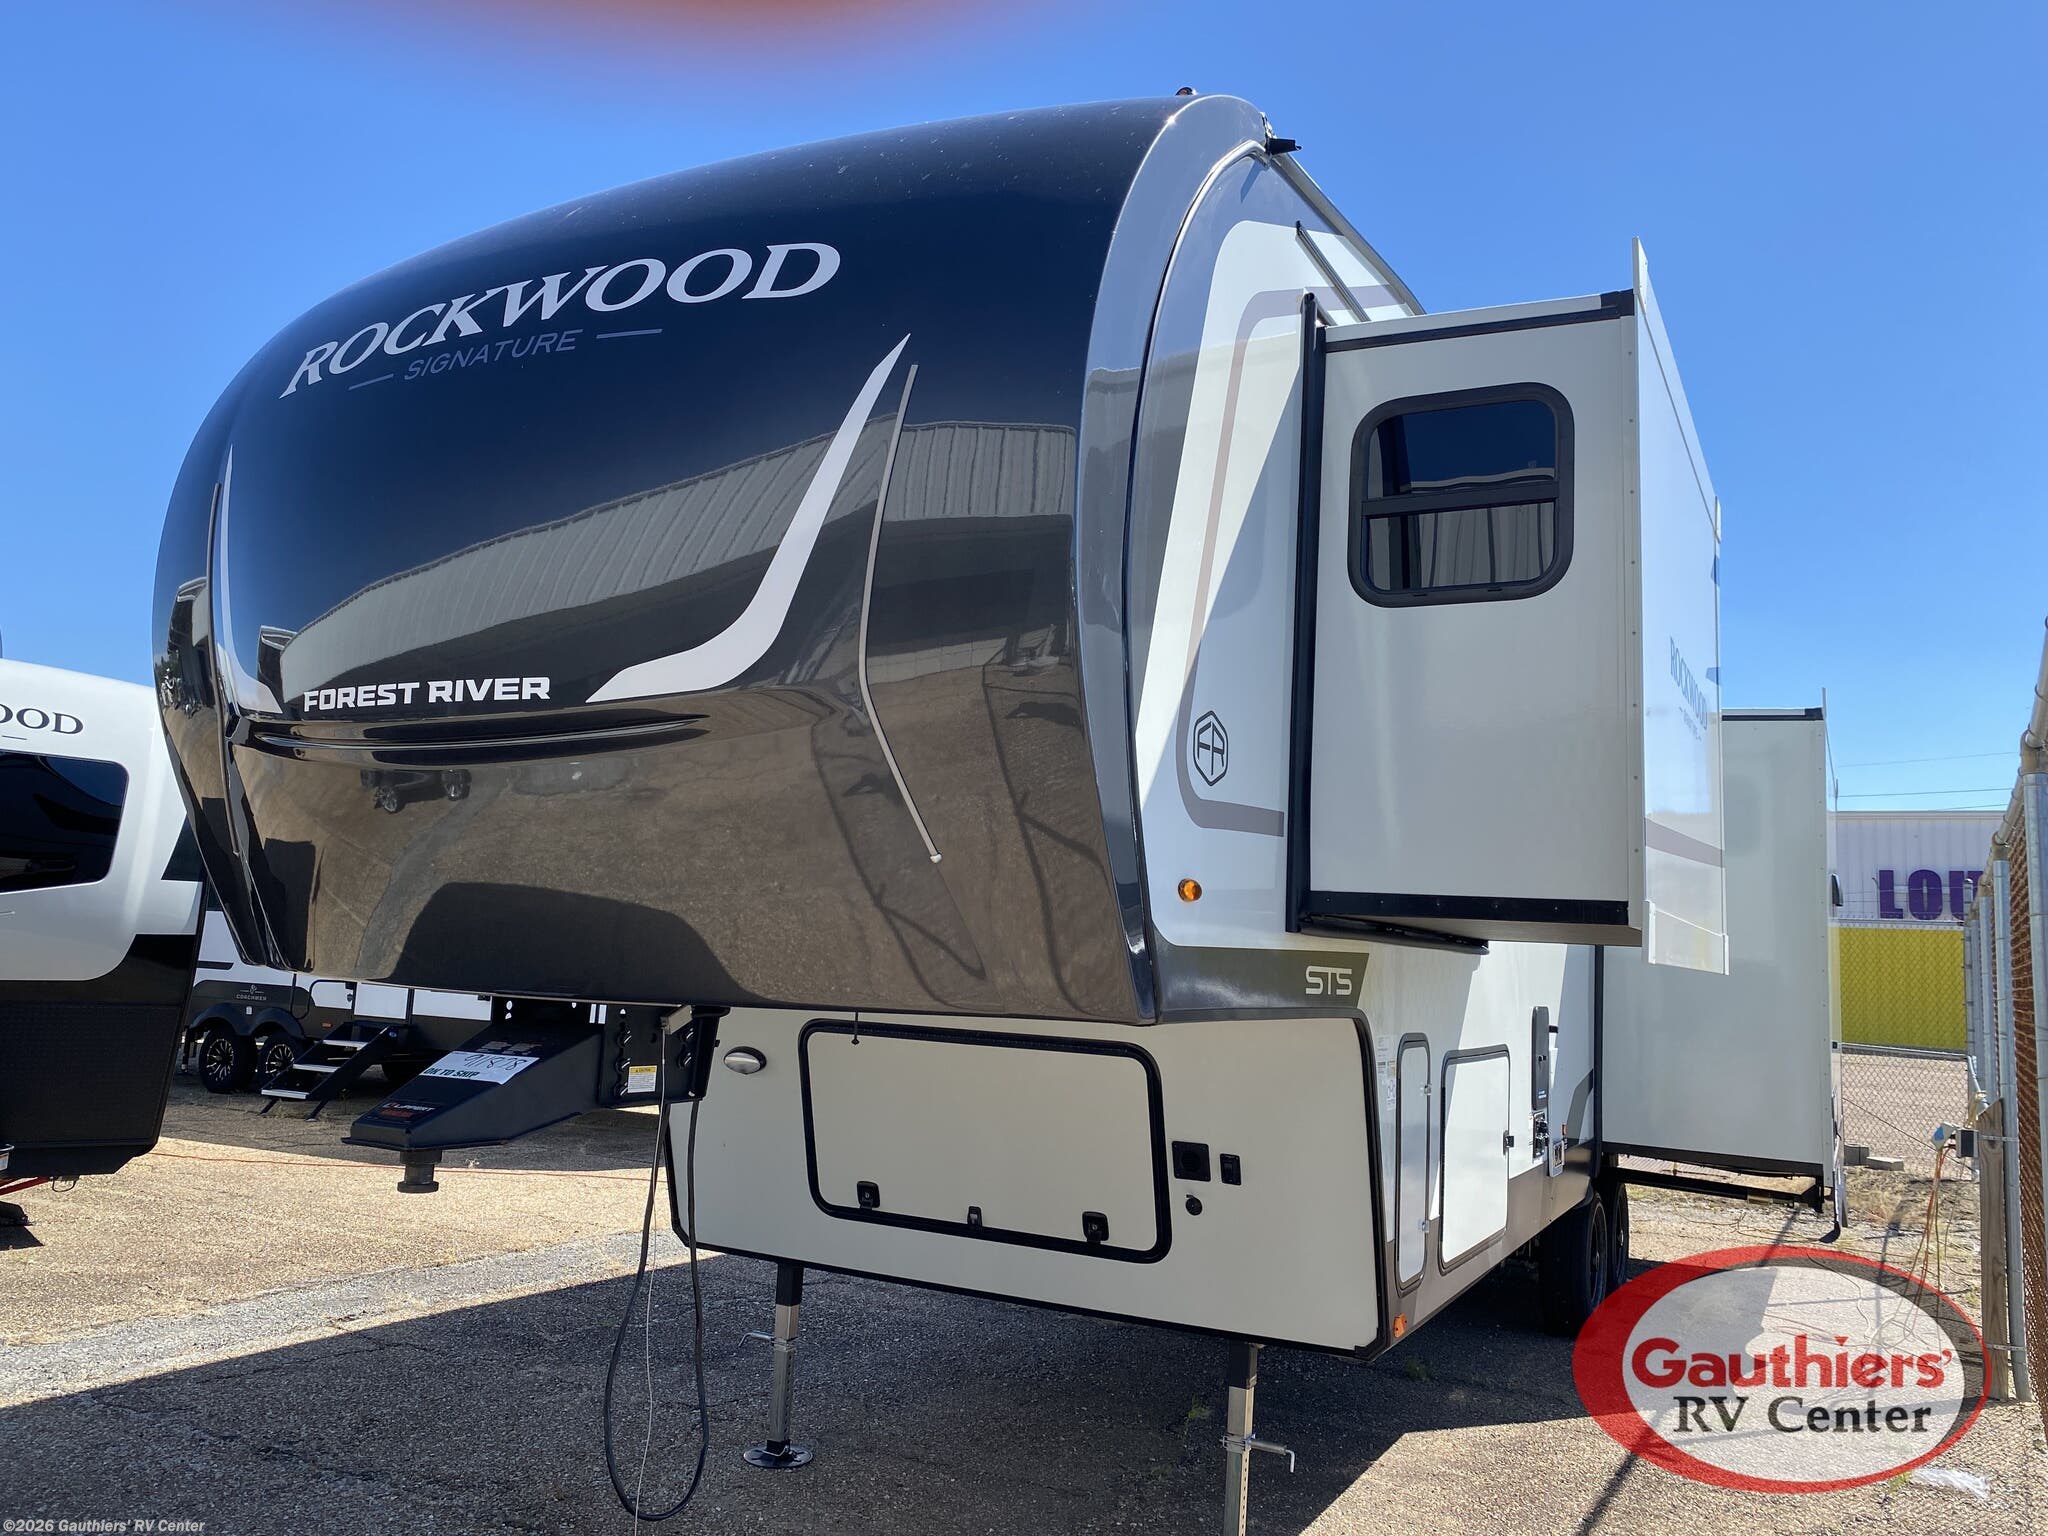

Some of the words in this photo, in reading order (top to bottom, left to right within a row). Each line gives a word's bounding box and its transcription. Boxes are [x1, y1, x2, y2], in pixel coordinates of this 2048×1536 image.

[279, 242, 841, 399] ROCKWOOD
[404, 329, 584, 381] SIGNATURE
[303, 682, 420, 712] FOREST
[427, 677, 550, 703] RIVER
[1670, 635, 1708, 730] ROCKWOOD
[1305, 965, 1353, 996] STS
[440, 1069, 455, 1077] TO
[454, 1070, 480, 1078] SHIP
